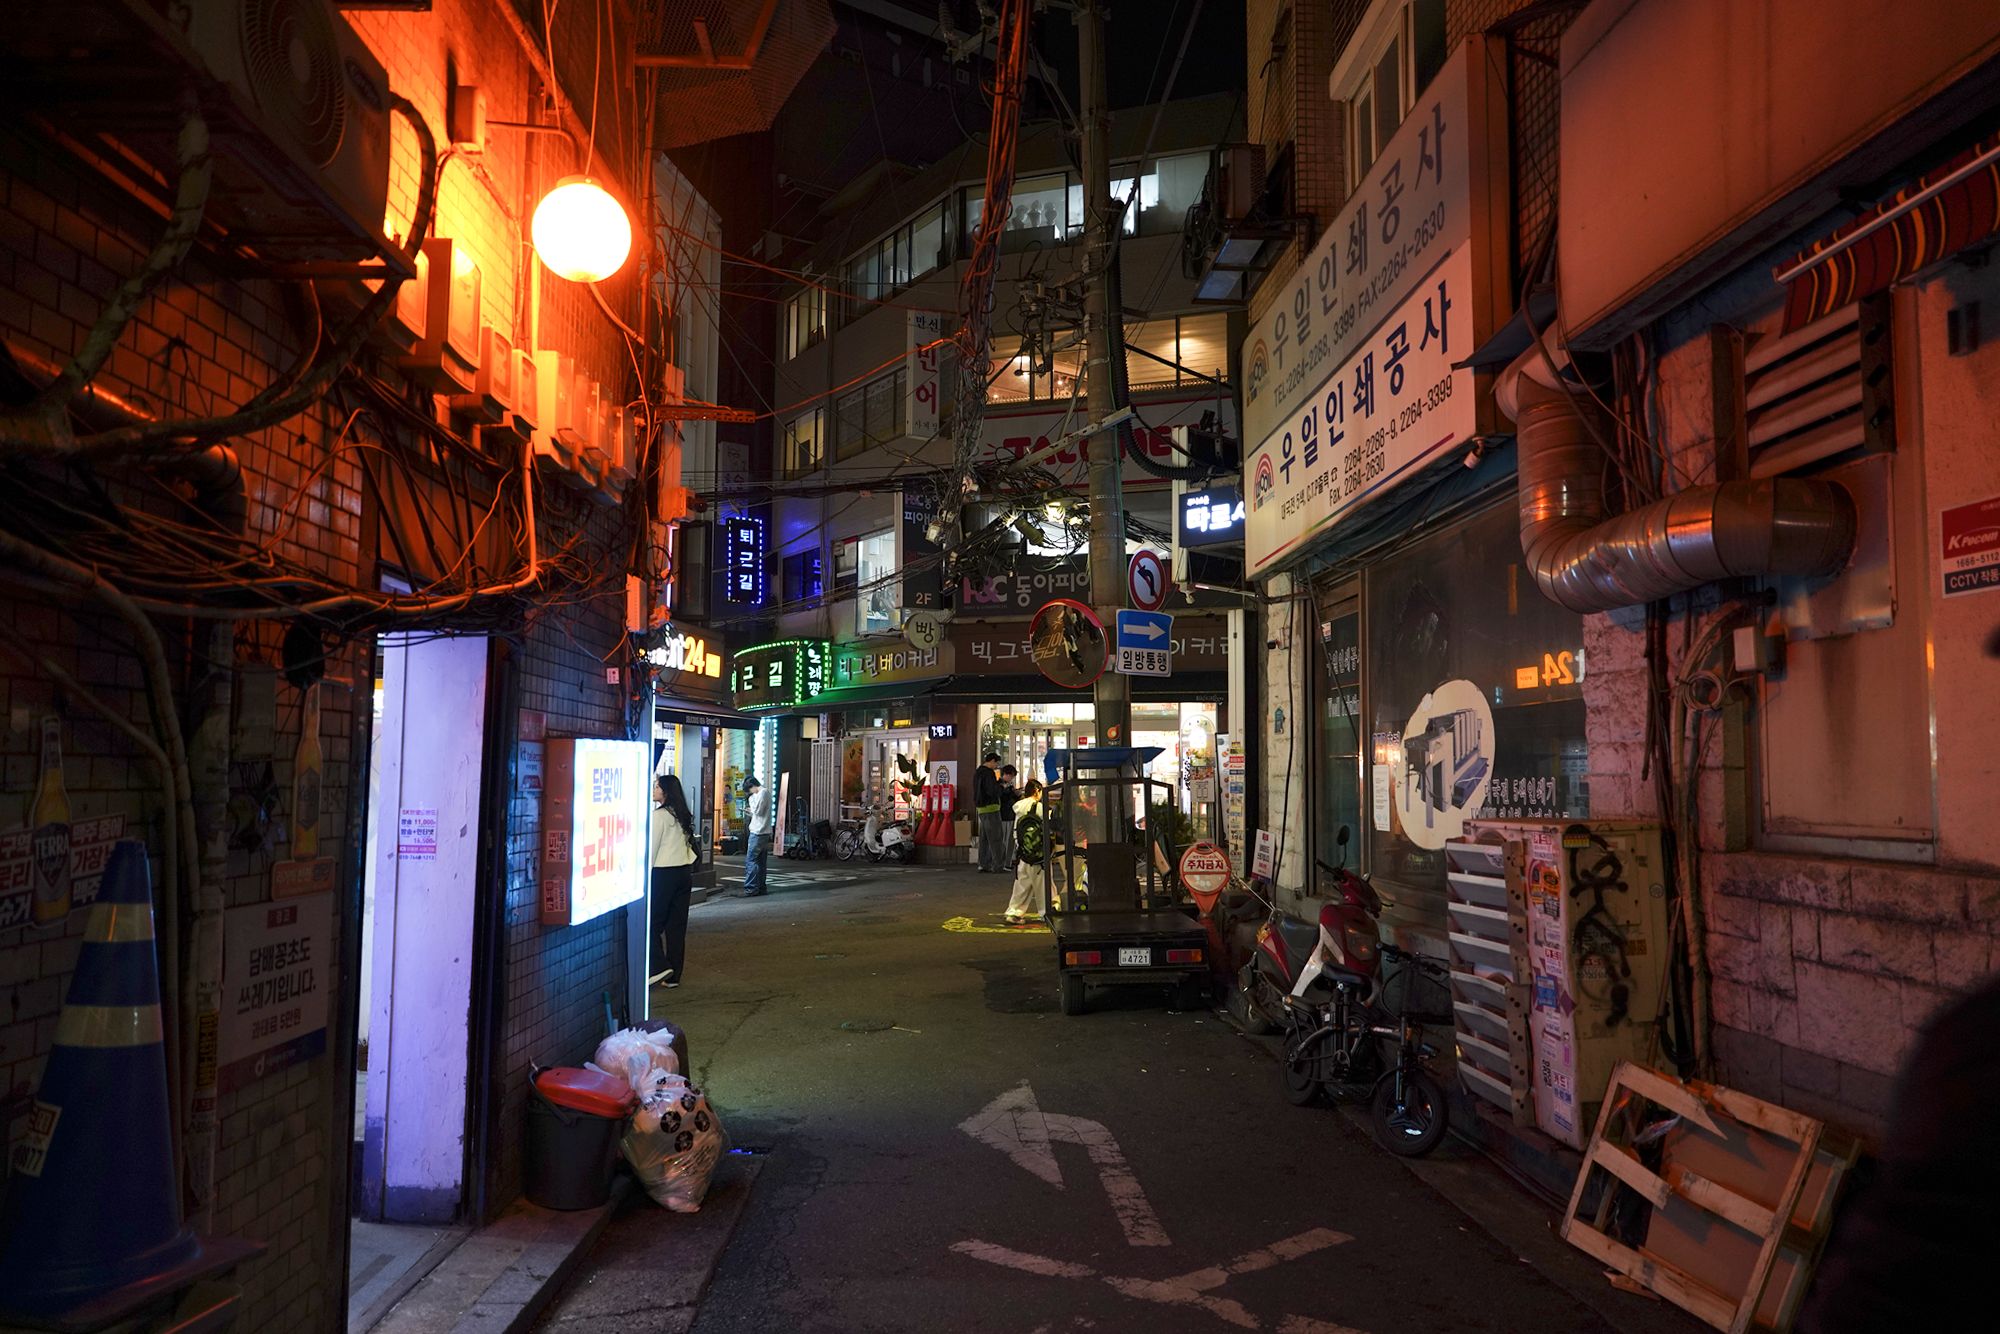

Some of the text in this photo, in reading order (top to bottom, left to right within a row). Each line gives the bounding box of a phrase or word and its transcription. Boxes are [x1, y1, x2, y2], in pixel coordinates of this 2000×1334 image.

[1273, 101, 1447, 370] 우일인쇄공사
[1357, 201, 1446, 319] FAX:2264-2630
[1280, 280, 1453, 486] 우일인쇄공사
[1400, 373, 1453, 433] 2264-3399
[1343, 451, 1385, 497] 2264-2630
[739, 528, 754, 591] 퇴근길
[1950, 573, 1979, 589] CCTV
[915, 592, 933, 605] 2F
[916, 622, 945, 644] 빵
[839, 648, 939, 681] 빅그린베이커리
[1130, 649, 1169, 673] 일방통행
[593, 767, 622, 804] 달맞이
[35, 832, 70, 860] TERRA
[73, 848, 102, 873] 가장
[1187, 859, 1224, 870] 주차금지
[249, 936, 312, 978] 담배꽁초도
[1128, 954, 1149, 964] 4721
[236, 967, 317, 1015] 쓰레기입니다.
[279, 1008, 302, 1030] 5만원
